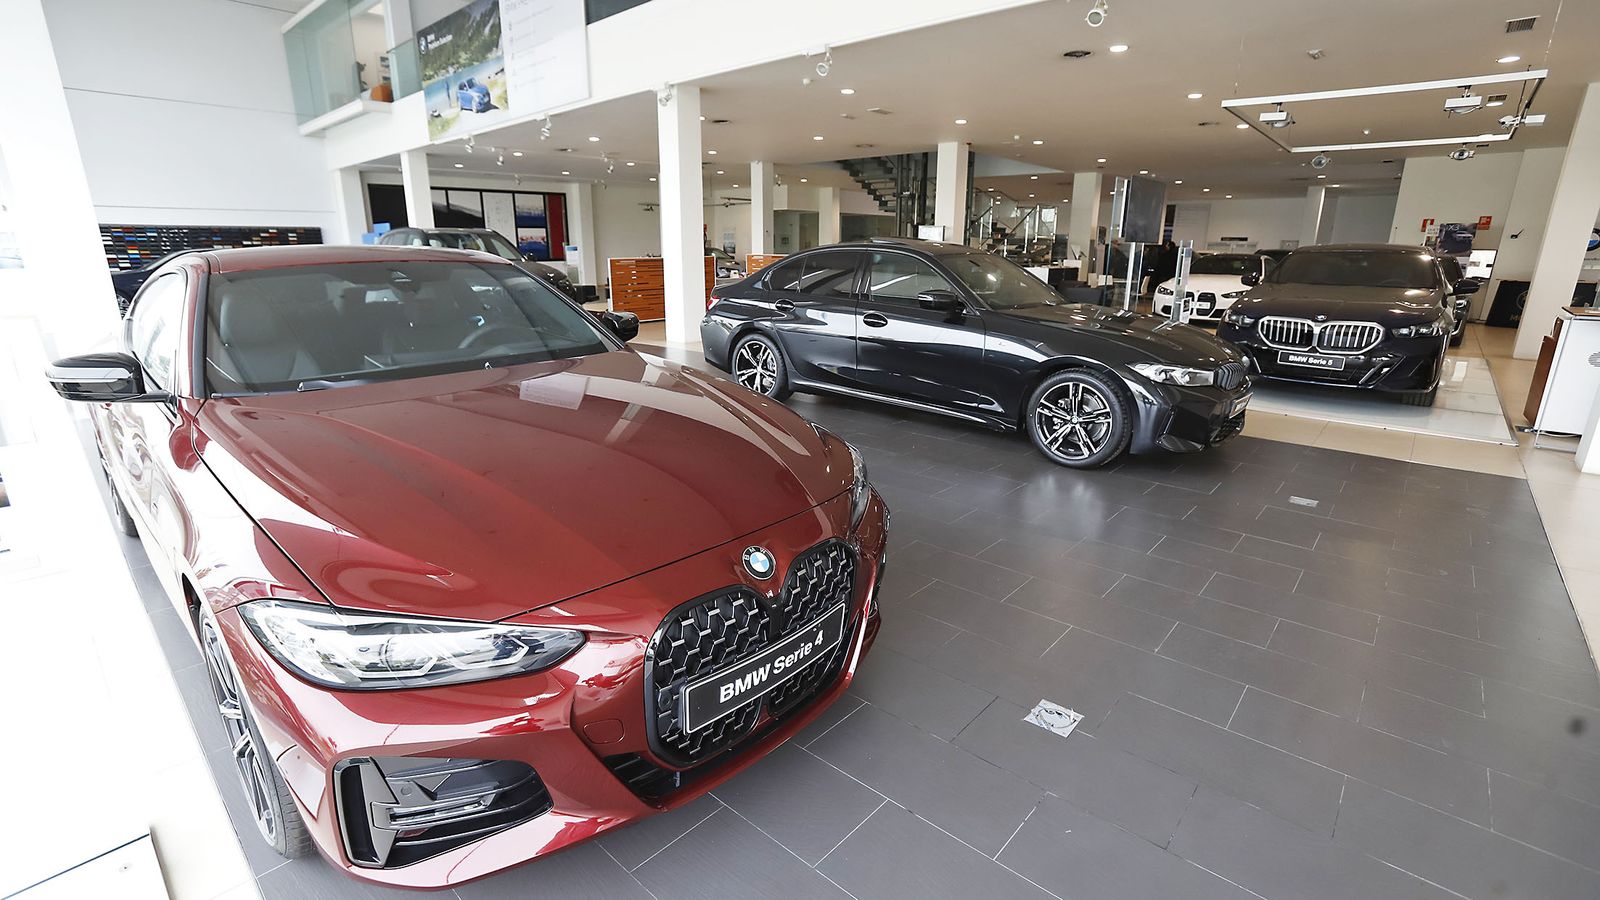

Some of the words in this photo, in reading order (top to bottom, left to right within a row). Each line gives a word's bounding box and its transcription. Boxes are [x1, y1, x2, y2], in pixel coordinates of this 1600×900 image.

[1289, 355, 1308, 363] BMW
[1308, 357, 1326, 365] Serie
[744, 547, 767, 560] BMW
[720, 663, 771, 704] BMW
[773, 643, 813, 675] Serie
[815, 629, 824, 646] 4
